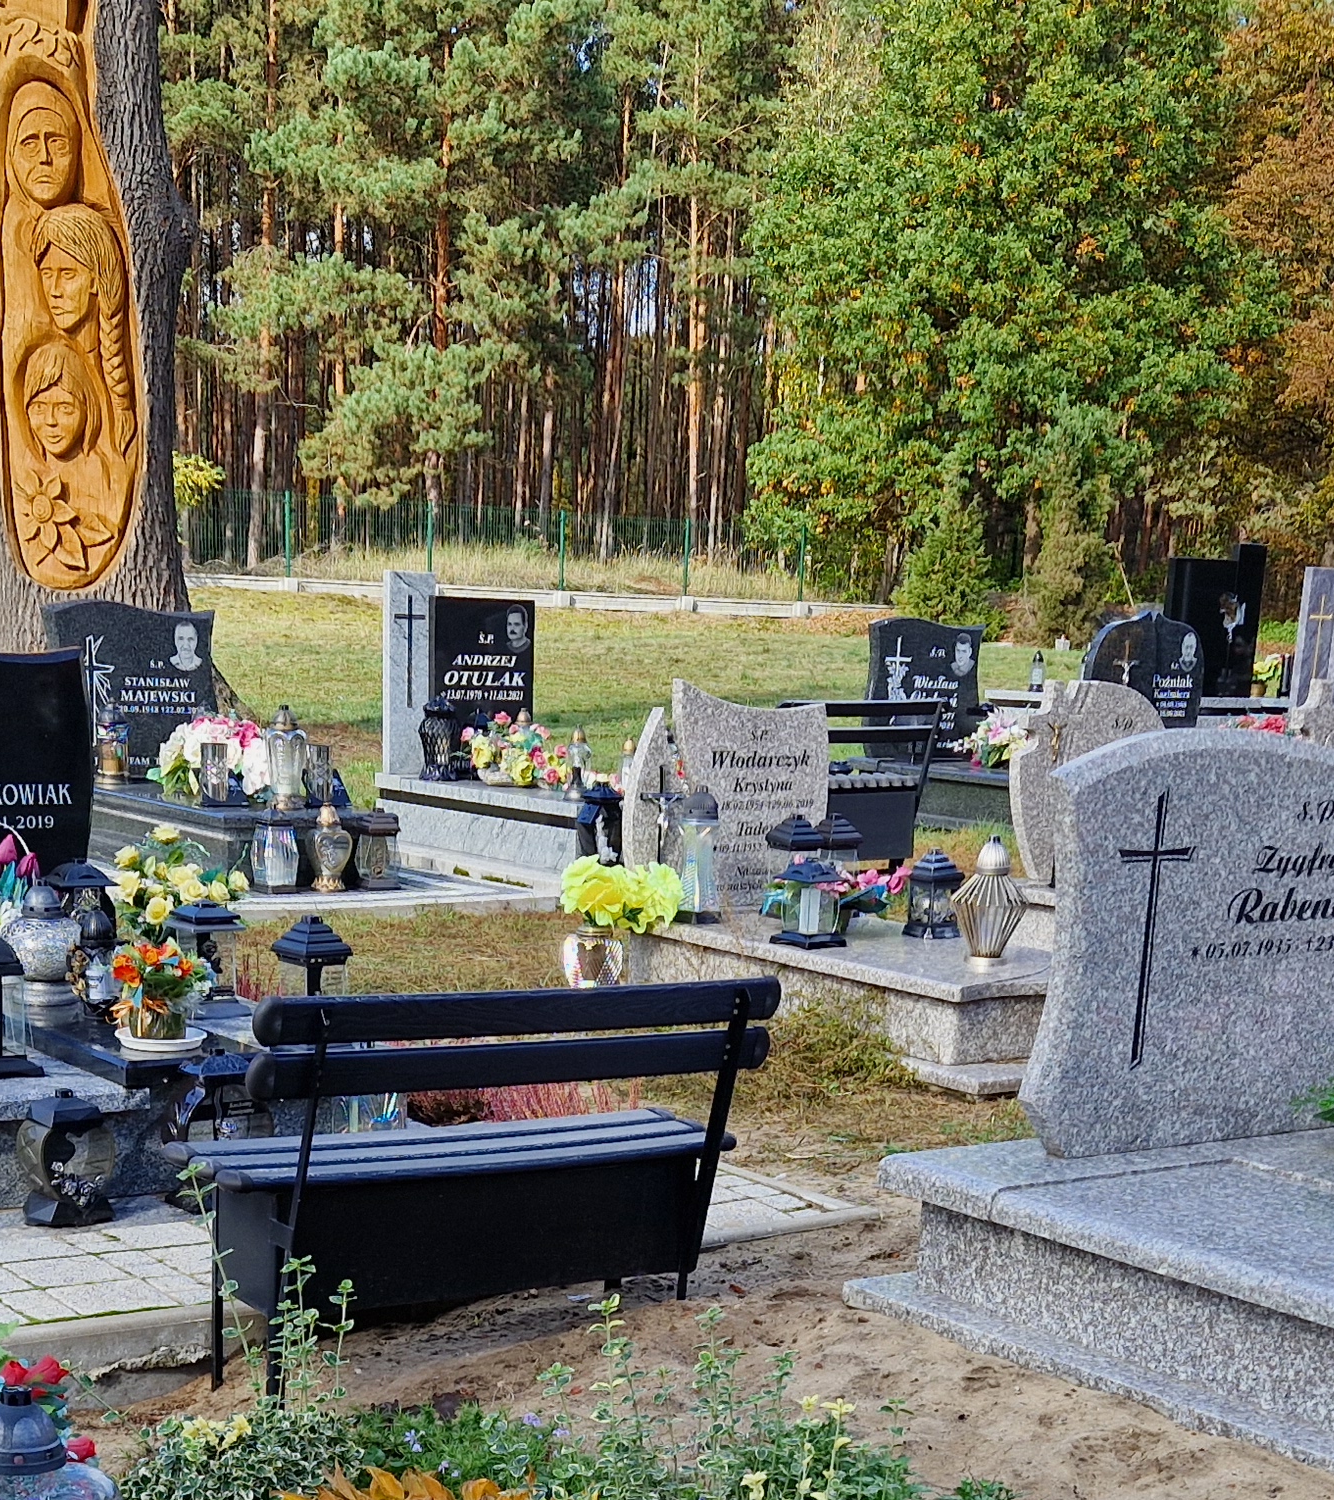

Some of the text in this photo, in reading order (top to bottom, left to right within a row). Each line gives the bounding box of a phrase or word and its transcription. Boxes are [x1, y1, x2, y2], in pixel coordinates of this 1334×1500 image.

[452, 654, 517, 667] ANDRZEJ
[124, 676, 190, 688] STANISŁAW
[443, 670, 526, 687] OTULAK
[912, 675, 959, 689] Wiesław
[1152, 674, 1194, 688] Poźniak
[120, 689, 196, 704] MAJEWSKI
[711, 749, 811, 773] Włodarczyk
[733, 778, 793, 797] Krystyna
